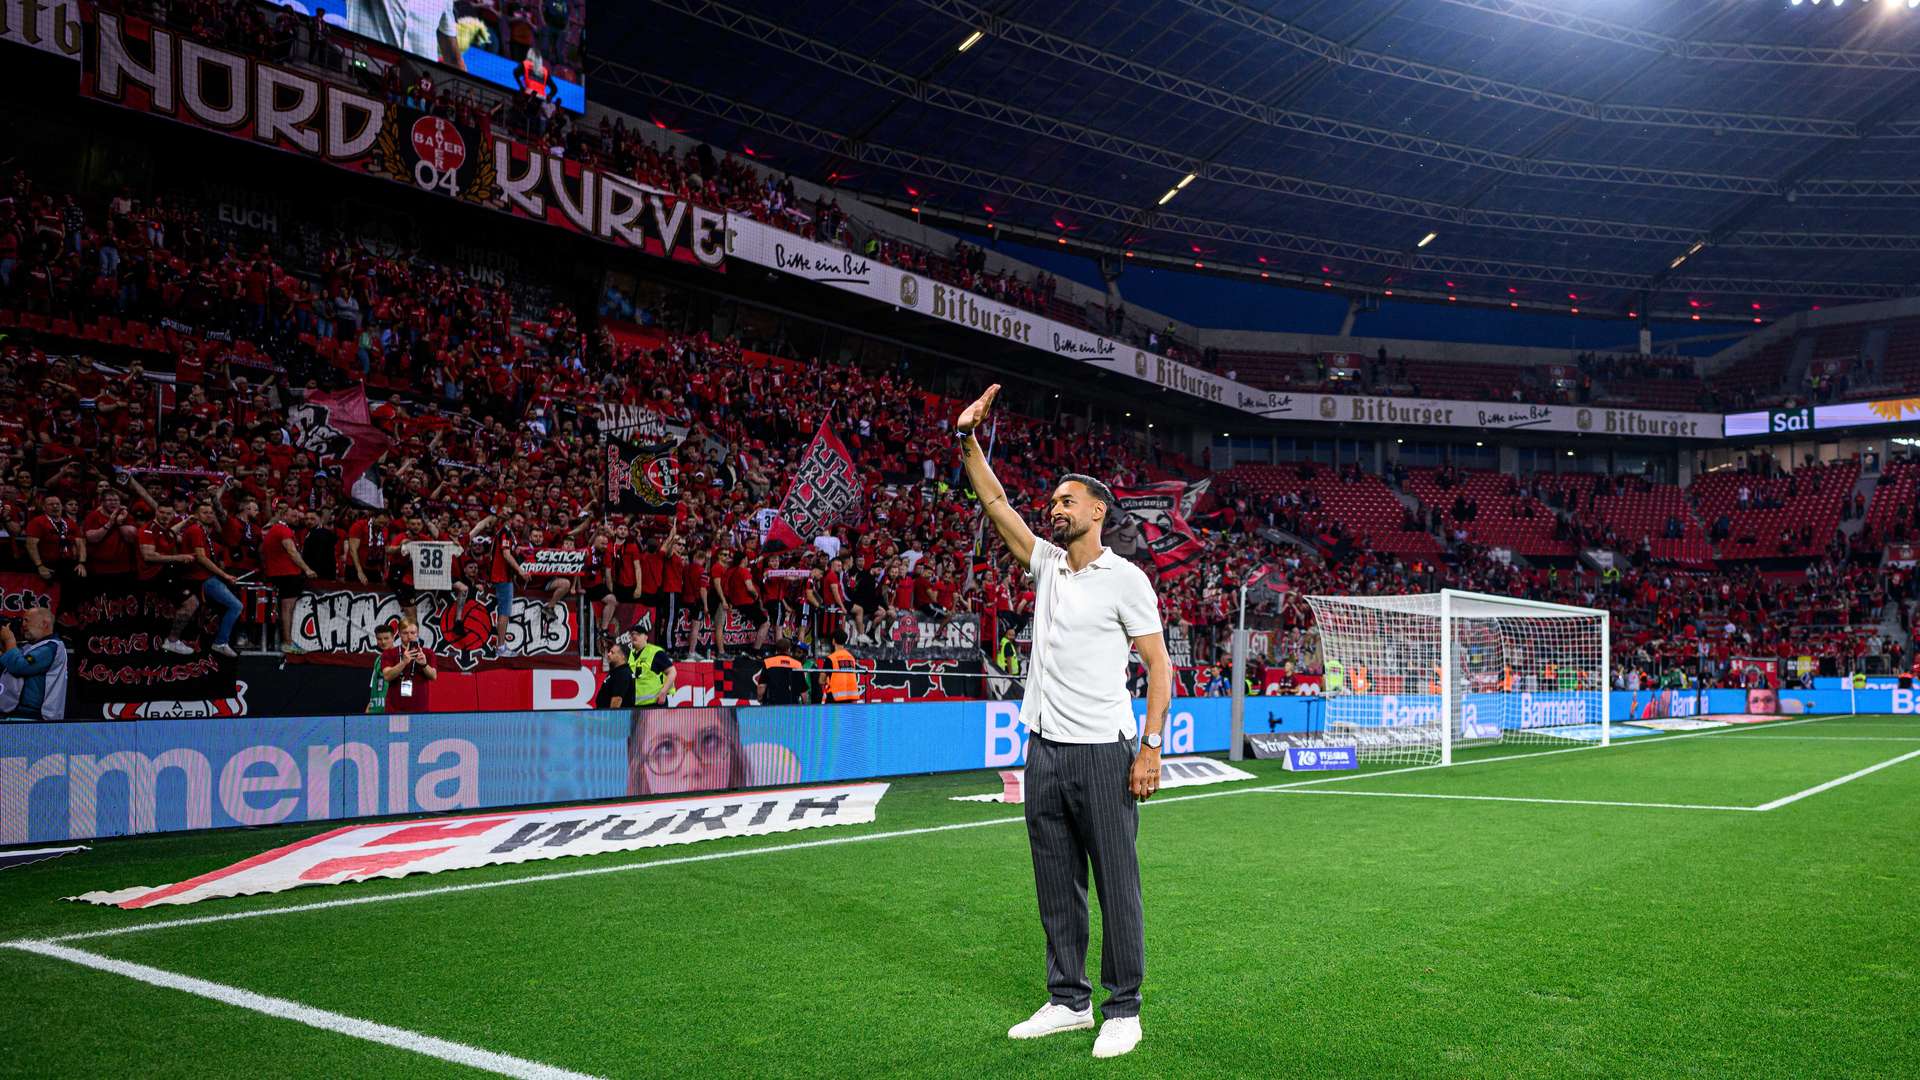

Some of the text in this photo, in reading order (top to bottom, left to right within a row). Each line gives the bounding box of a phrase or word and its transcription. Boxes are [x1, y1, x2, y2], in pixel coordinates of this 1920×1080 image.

[97, 10, 727, 267] NORD KURVE
[415, 160, 460, 196] 04
[216, 202, 278, 233] EUCH
[776, 243, 870, 275] Bitte ein Bit
[931, 283, 1032, 343] Bitburger
[1097, 337, 1115, 355] Bit
[1156, 357, 1223, 401] Bitburger
[1351, 397, 1453, 424] Bitburger
[1605, 408, 1698, 436] Bitburger
[1773, 409, 1809, 432] Sai
[420, 549, 443, 569] 38
[0, 716, 481, 842] rmenia
